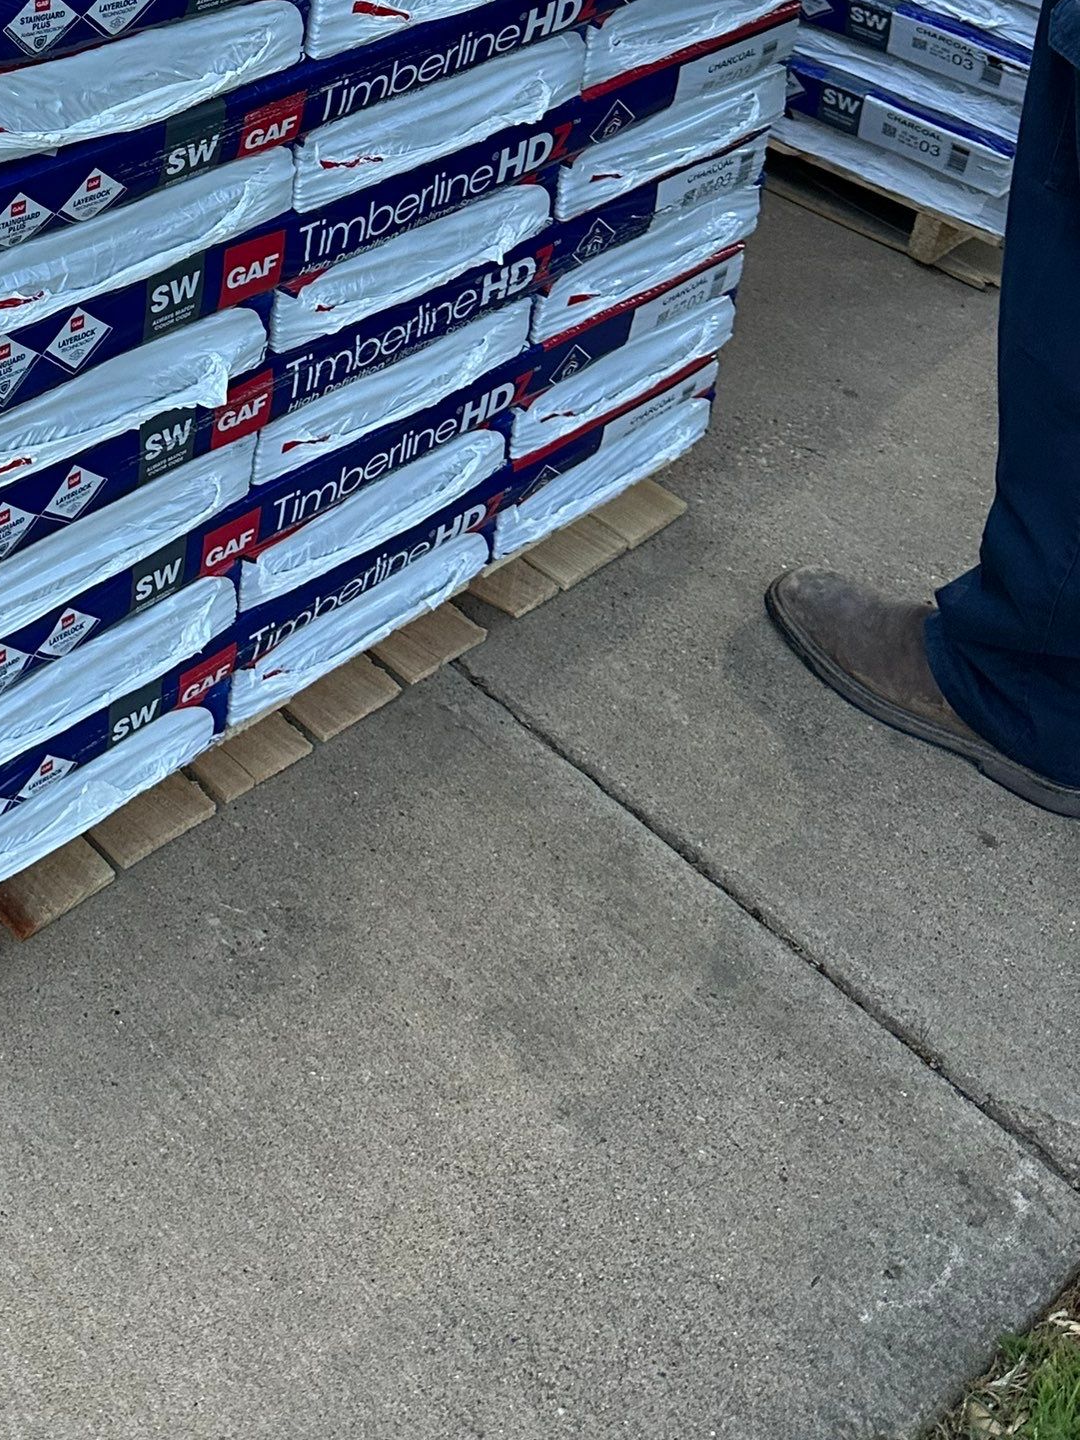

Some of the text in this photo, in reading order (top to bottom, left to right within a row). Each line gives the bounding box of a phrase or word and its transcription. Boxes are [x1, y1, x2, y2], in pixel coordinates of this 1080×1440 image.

[19, 10, 66, 26] STAINGUARD
[32, 20, 51, 30] PLUS
[821, 88, 862, 115] SW
[886, 112, 943, 143] CHARCOAL
[165, 133, 219, 176] SW
[244, 116, 298, 151] GAF
[918, 139, 941, 158] 03
[226, 253, 280, 290] GAF
[149, 270, 202, 315] SW
[57, 327, 97, 350] LAYERLOCK
[55, 481, 93, 506] LAYERLOCK
[205, 528, 255, 568] GAF
[111, 663, 230, 743] SW GAF
